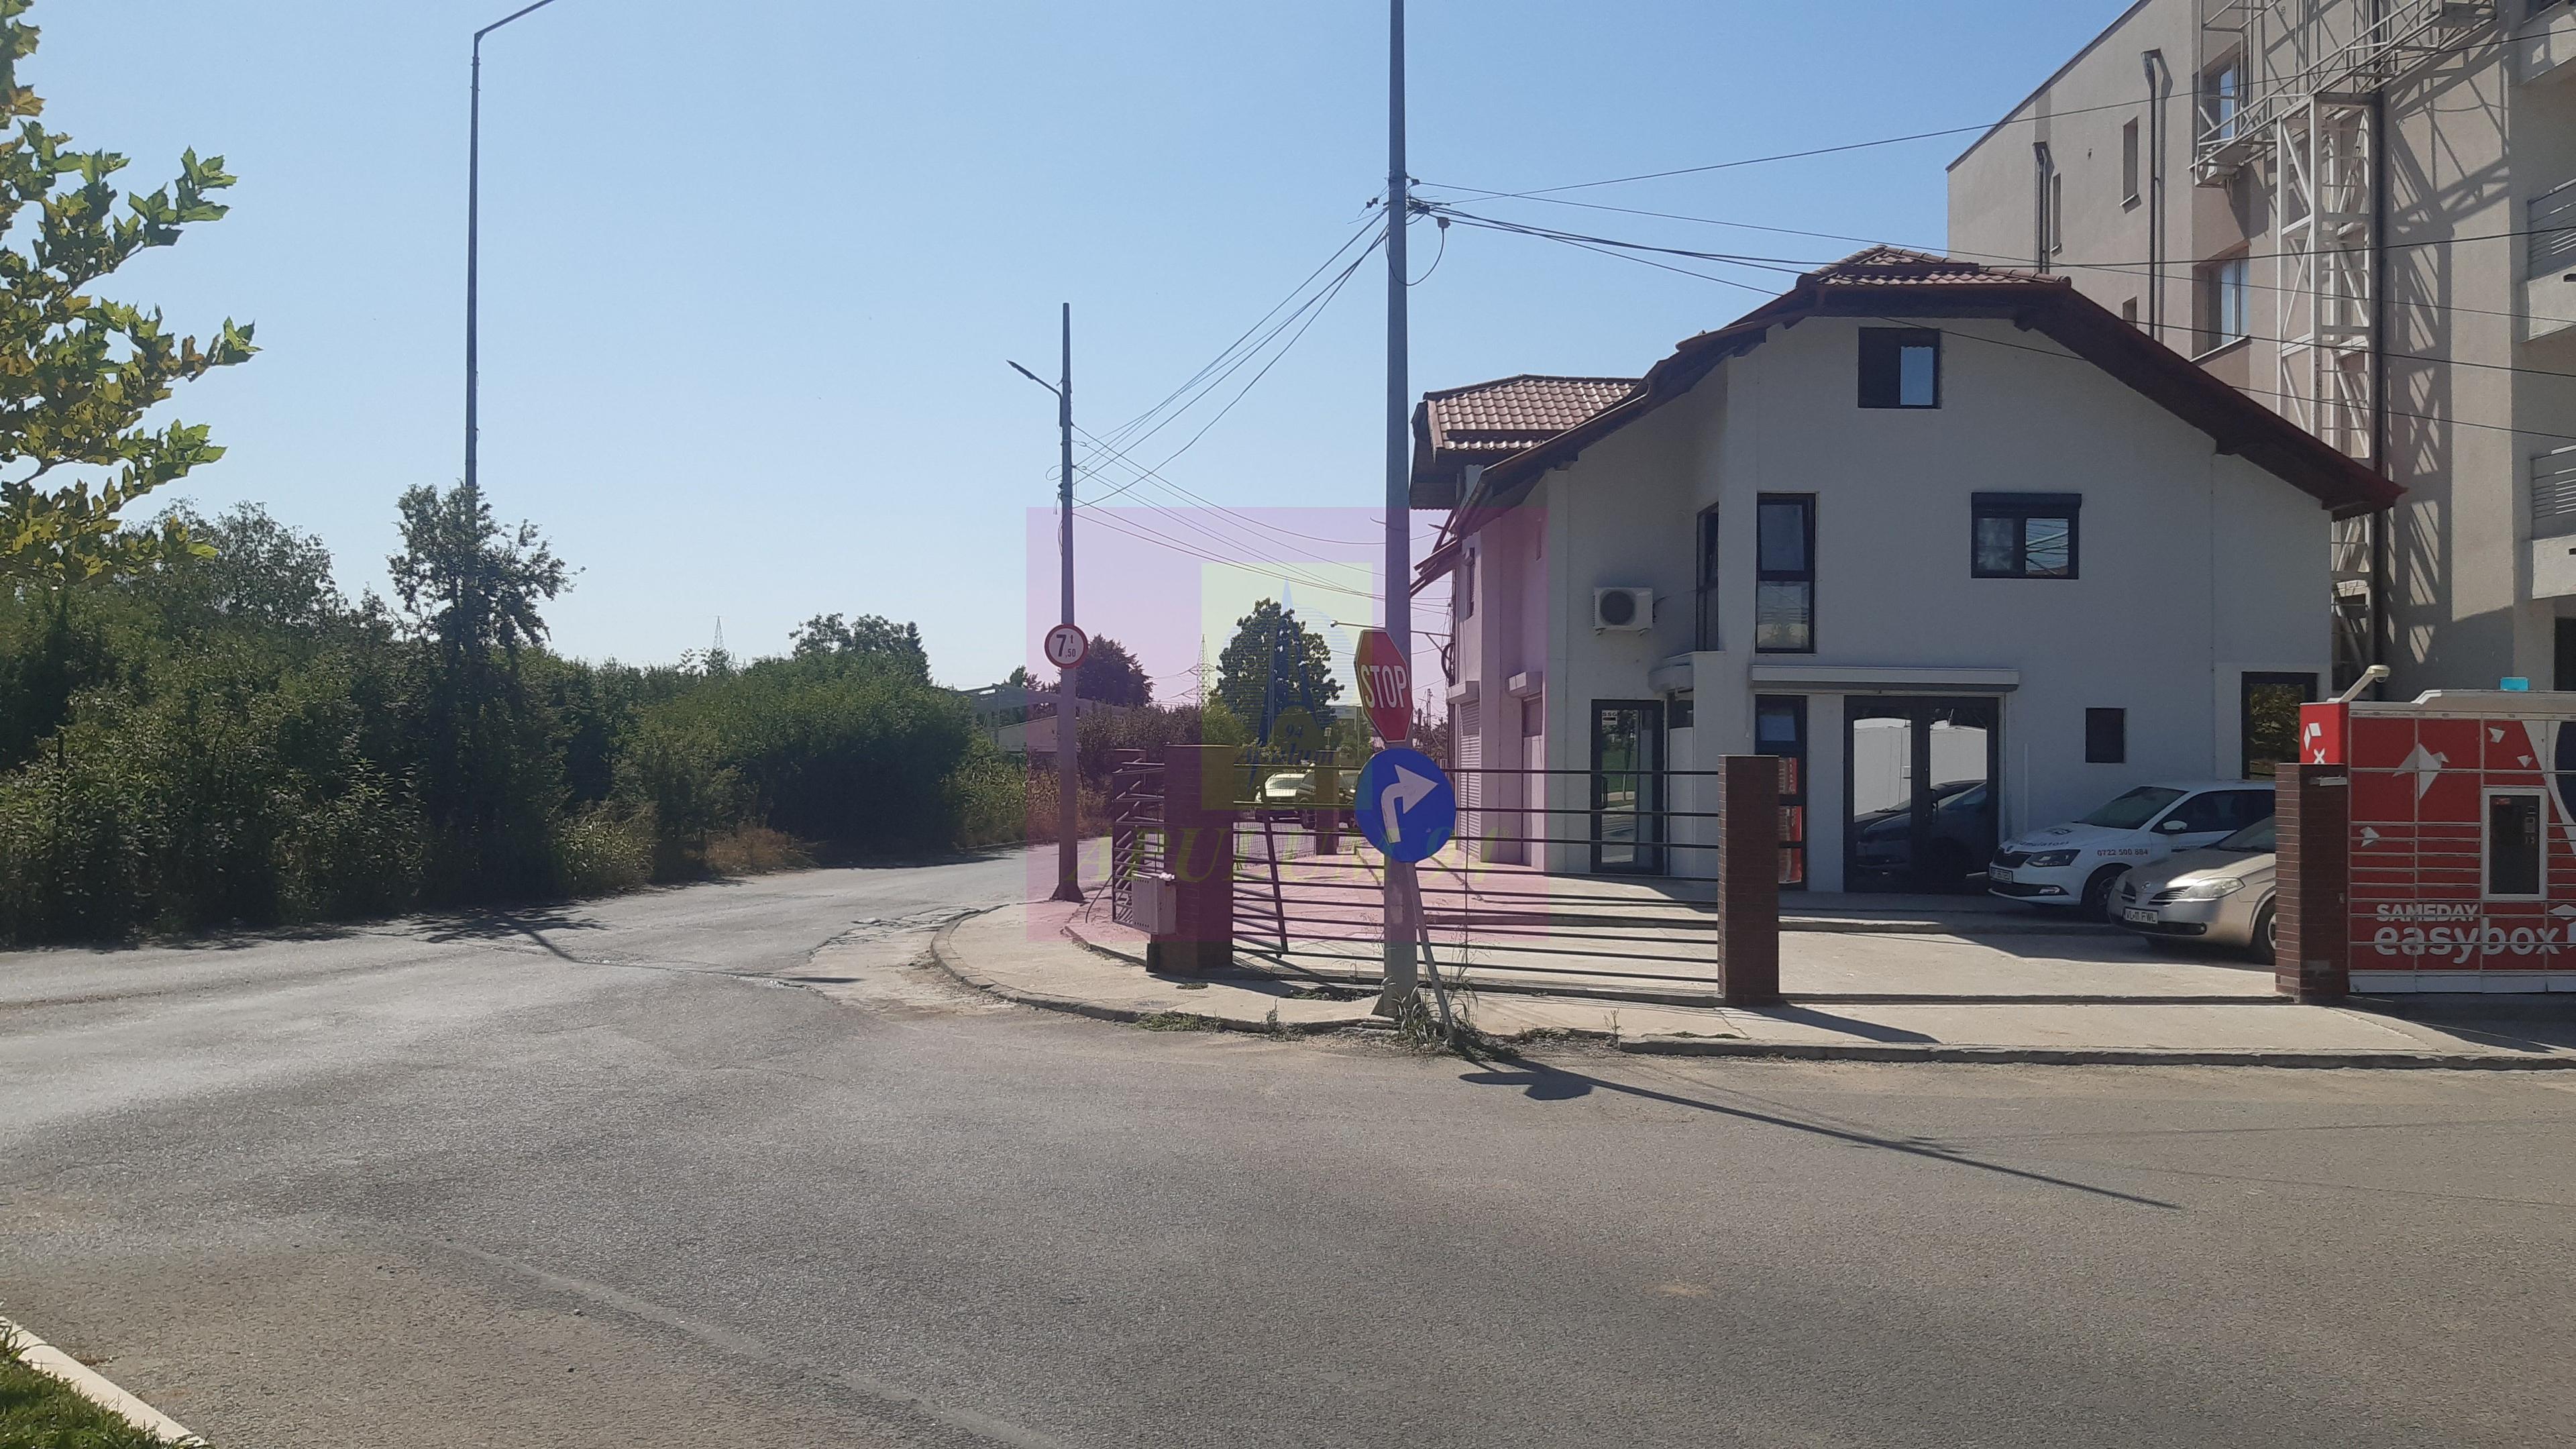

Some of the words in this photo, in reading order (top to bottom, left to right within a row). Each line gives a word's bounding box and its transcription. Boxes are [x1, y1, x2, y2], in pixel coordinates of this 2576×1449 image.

[1360, 664, 1407, 708] STOP
[2376, 904, 2479, 922] SAMEDAY
[2374, 916, 2560, 964] easybox
